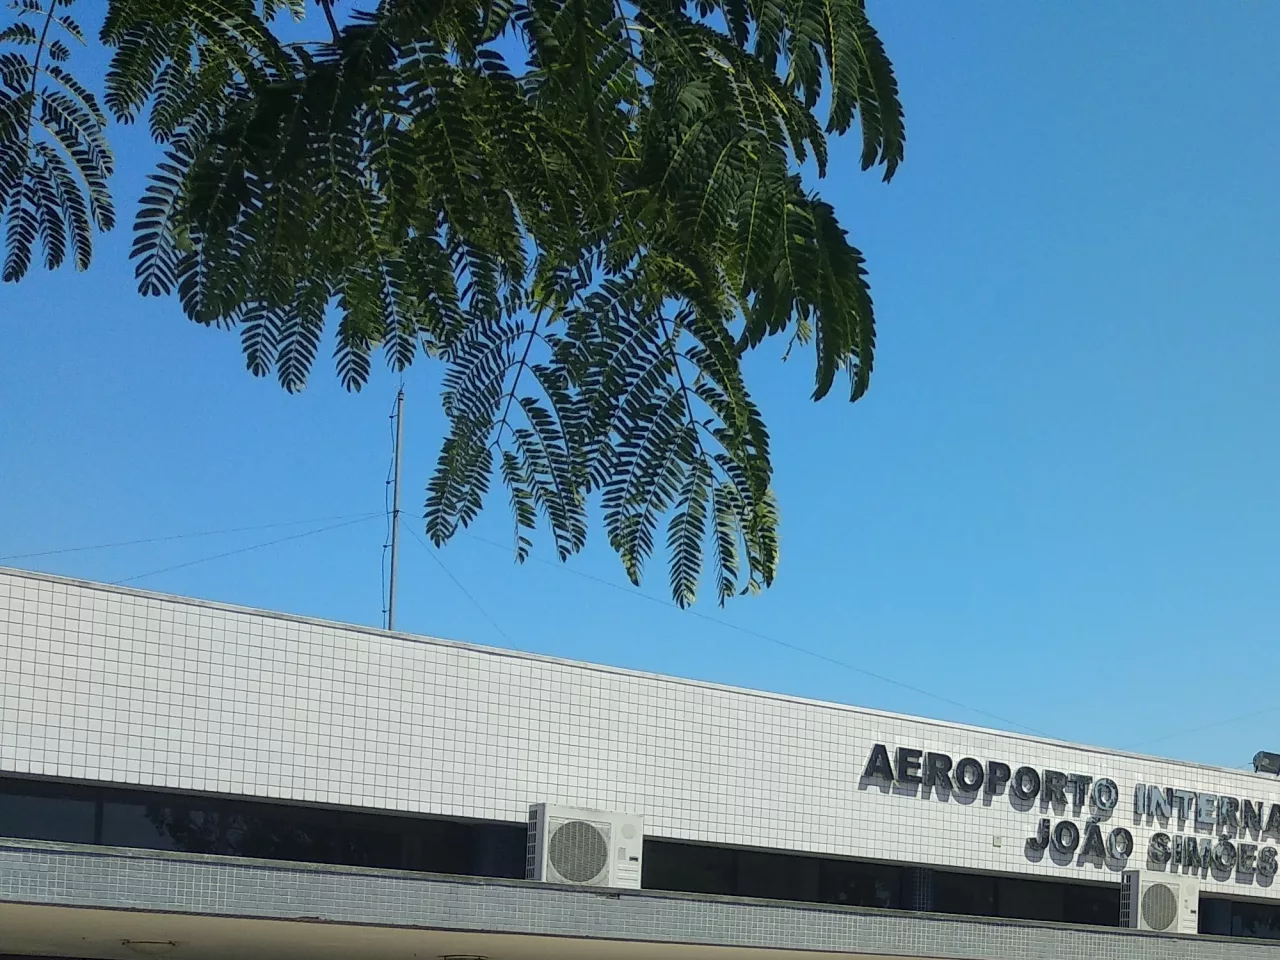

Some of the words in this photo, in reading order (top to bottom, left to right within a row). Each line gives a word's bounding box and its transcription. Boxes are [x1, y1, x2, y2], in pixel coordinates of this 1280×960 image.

[861, 743, 1119, 811] AEROPORTO
[1025, 815, 1134, 860] JOÃO
[1150, 831, 1279, 877] SIMÕES
